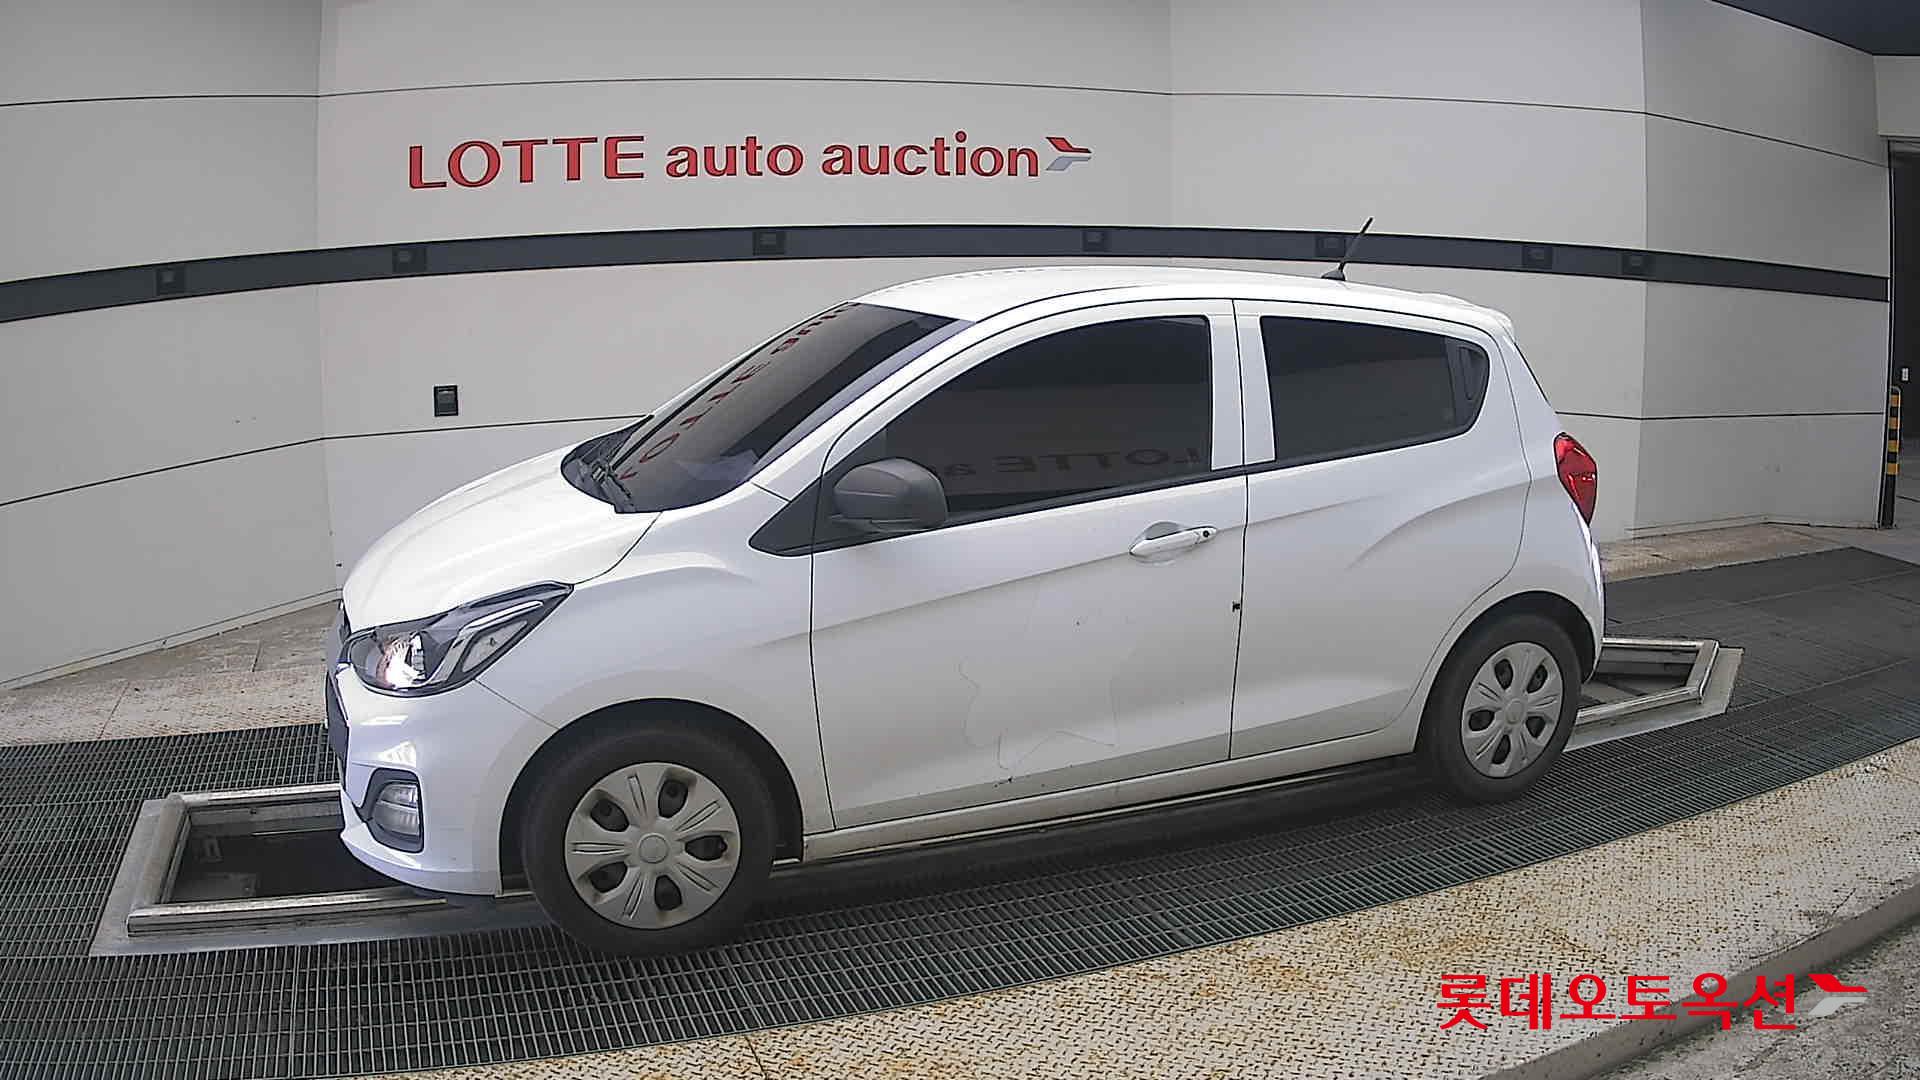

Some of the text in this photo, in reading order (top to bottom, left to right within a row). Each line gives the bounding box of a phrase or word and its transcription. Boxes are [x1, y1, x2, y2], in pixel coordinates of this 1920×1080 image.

[408, 130, 1040, 189] LOTTE auto auction
